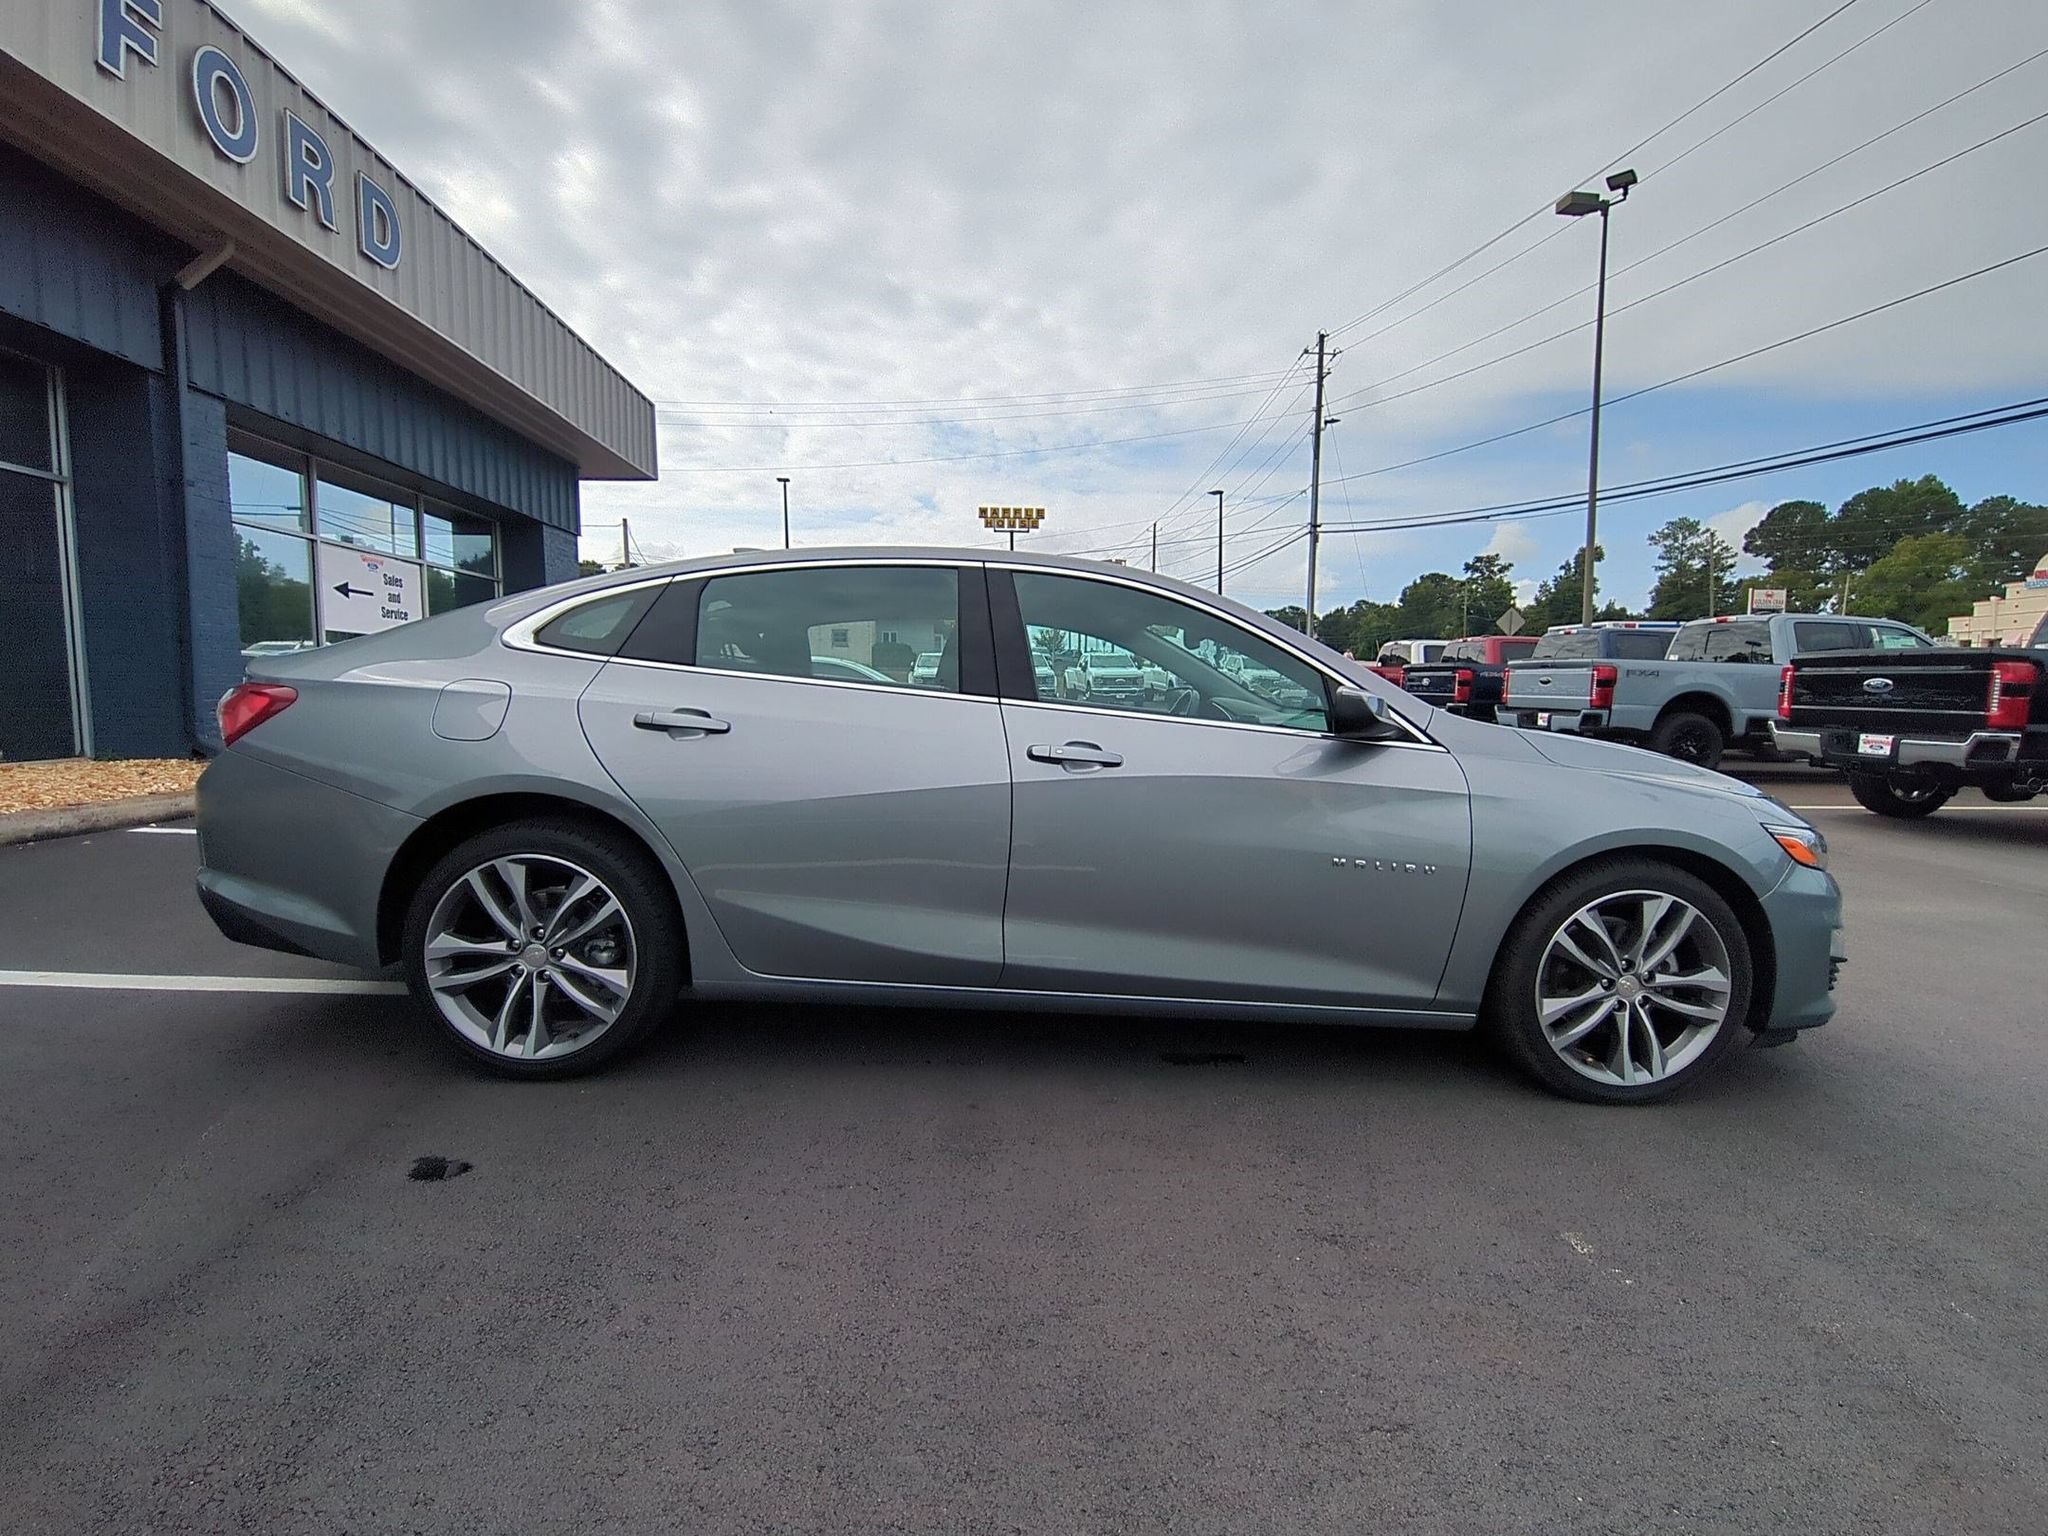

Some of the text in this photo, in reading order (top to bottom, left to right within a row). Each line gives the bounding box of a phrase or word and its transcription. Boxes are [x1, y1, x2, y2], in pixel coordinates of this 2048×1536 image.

[97, 0, 403, 270] FORD
[979, 507, 1044, 518] WAFFLE
[985, 519, 1039, 528] HOUSE
[383, 573, 403, 588] Sales
[388, 592, 401, 604] and
[381, 606, 408, 621] Service
[1332, 857, 1437, 875] MALIBU
